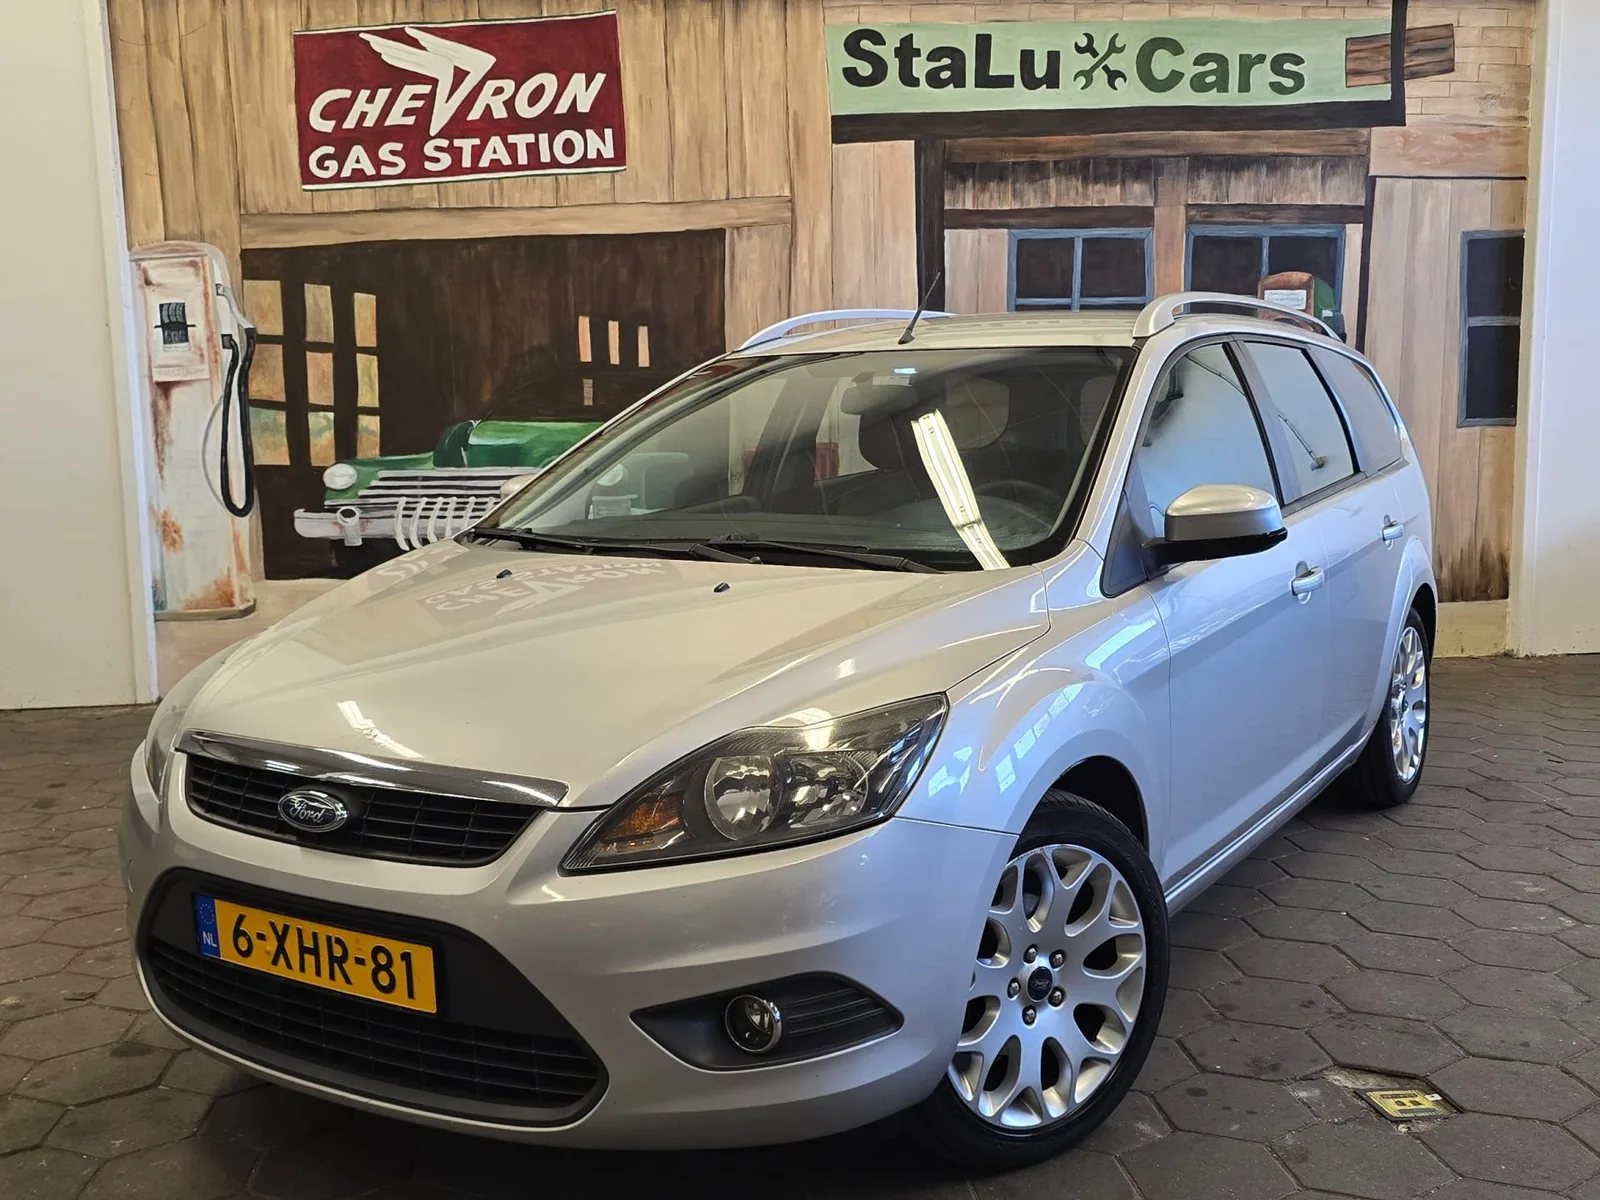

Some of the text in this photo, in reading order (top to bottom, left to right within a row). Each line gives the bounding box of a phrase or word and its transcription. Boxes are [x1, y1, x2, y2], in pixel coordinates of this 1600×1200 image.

[841, 28, 1307, 96] StaLu Cars
[308, 50, 607, 137] CHEVRON
[308, 128, 615, 179] GAS STATION
[289, 798, 327, 823] Ford
[202, 931, 218, 948] NL
[232, 913, 416, 1001] 6-XHR-81
